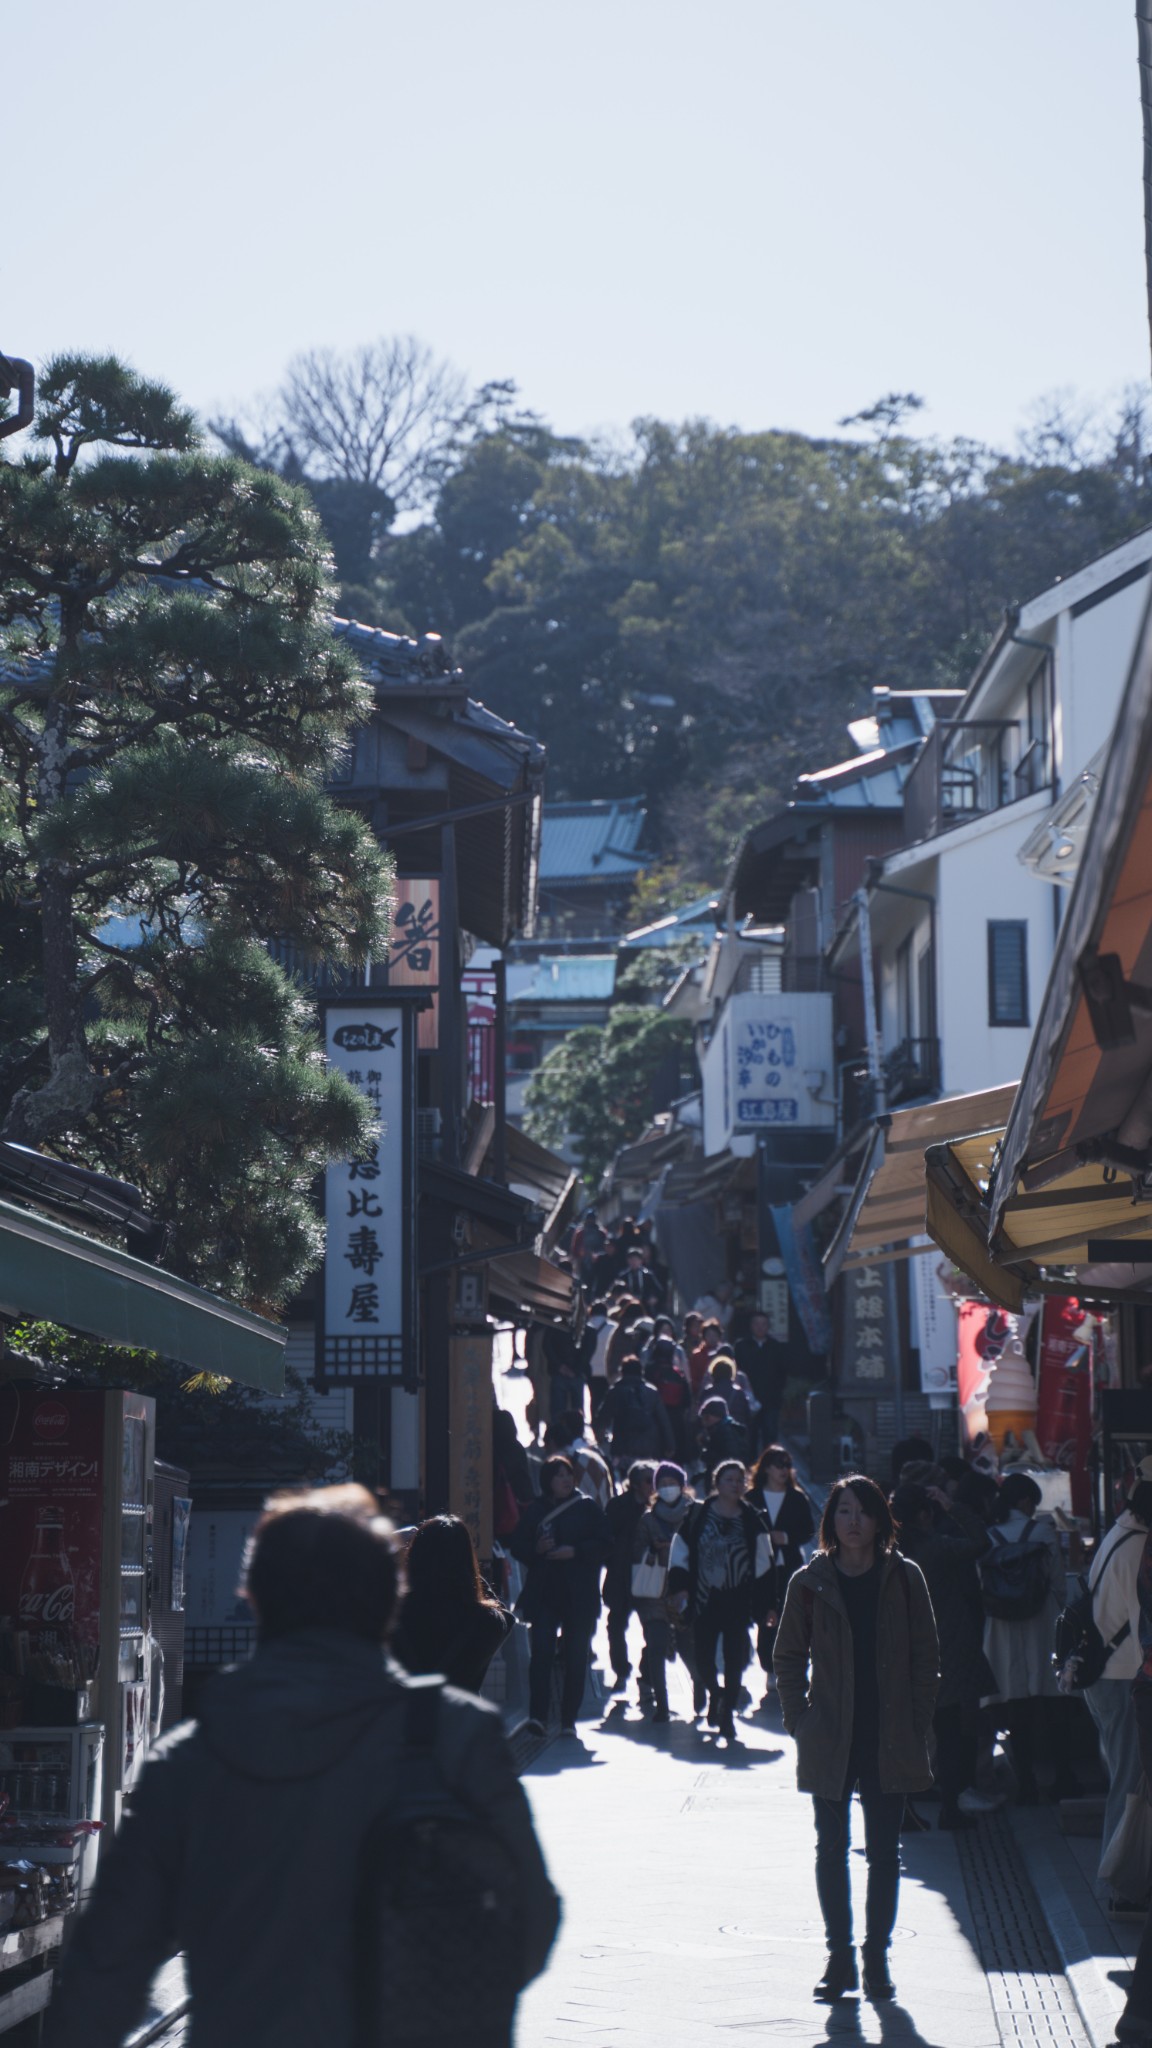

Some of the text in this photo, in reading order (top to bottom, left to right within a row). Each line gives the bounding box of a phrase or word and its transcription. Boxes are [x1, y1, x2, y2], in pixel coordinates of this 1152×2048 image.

[390, 899, 439, 971] 箸
[9, 1461, 98, 1478] 湘南デザイン!
